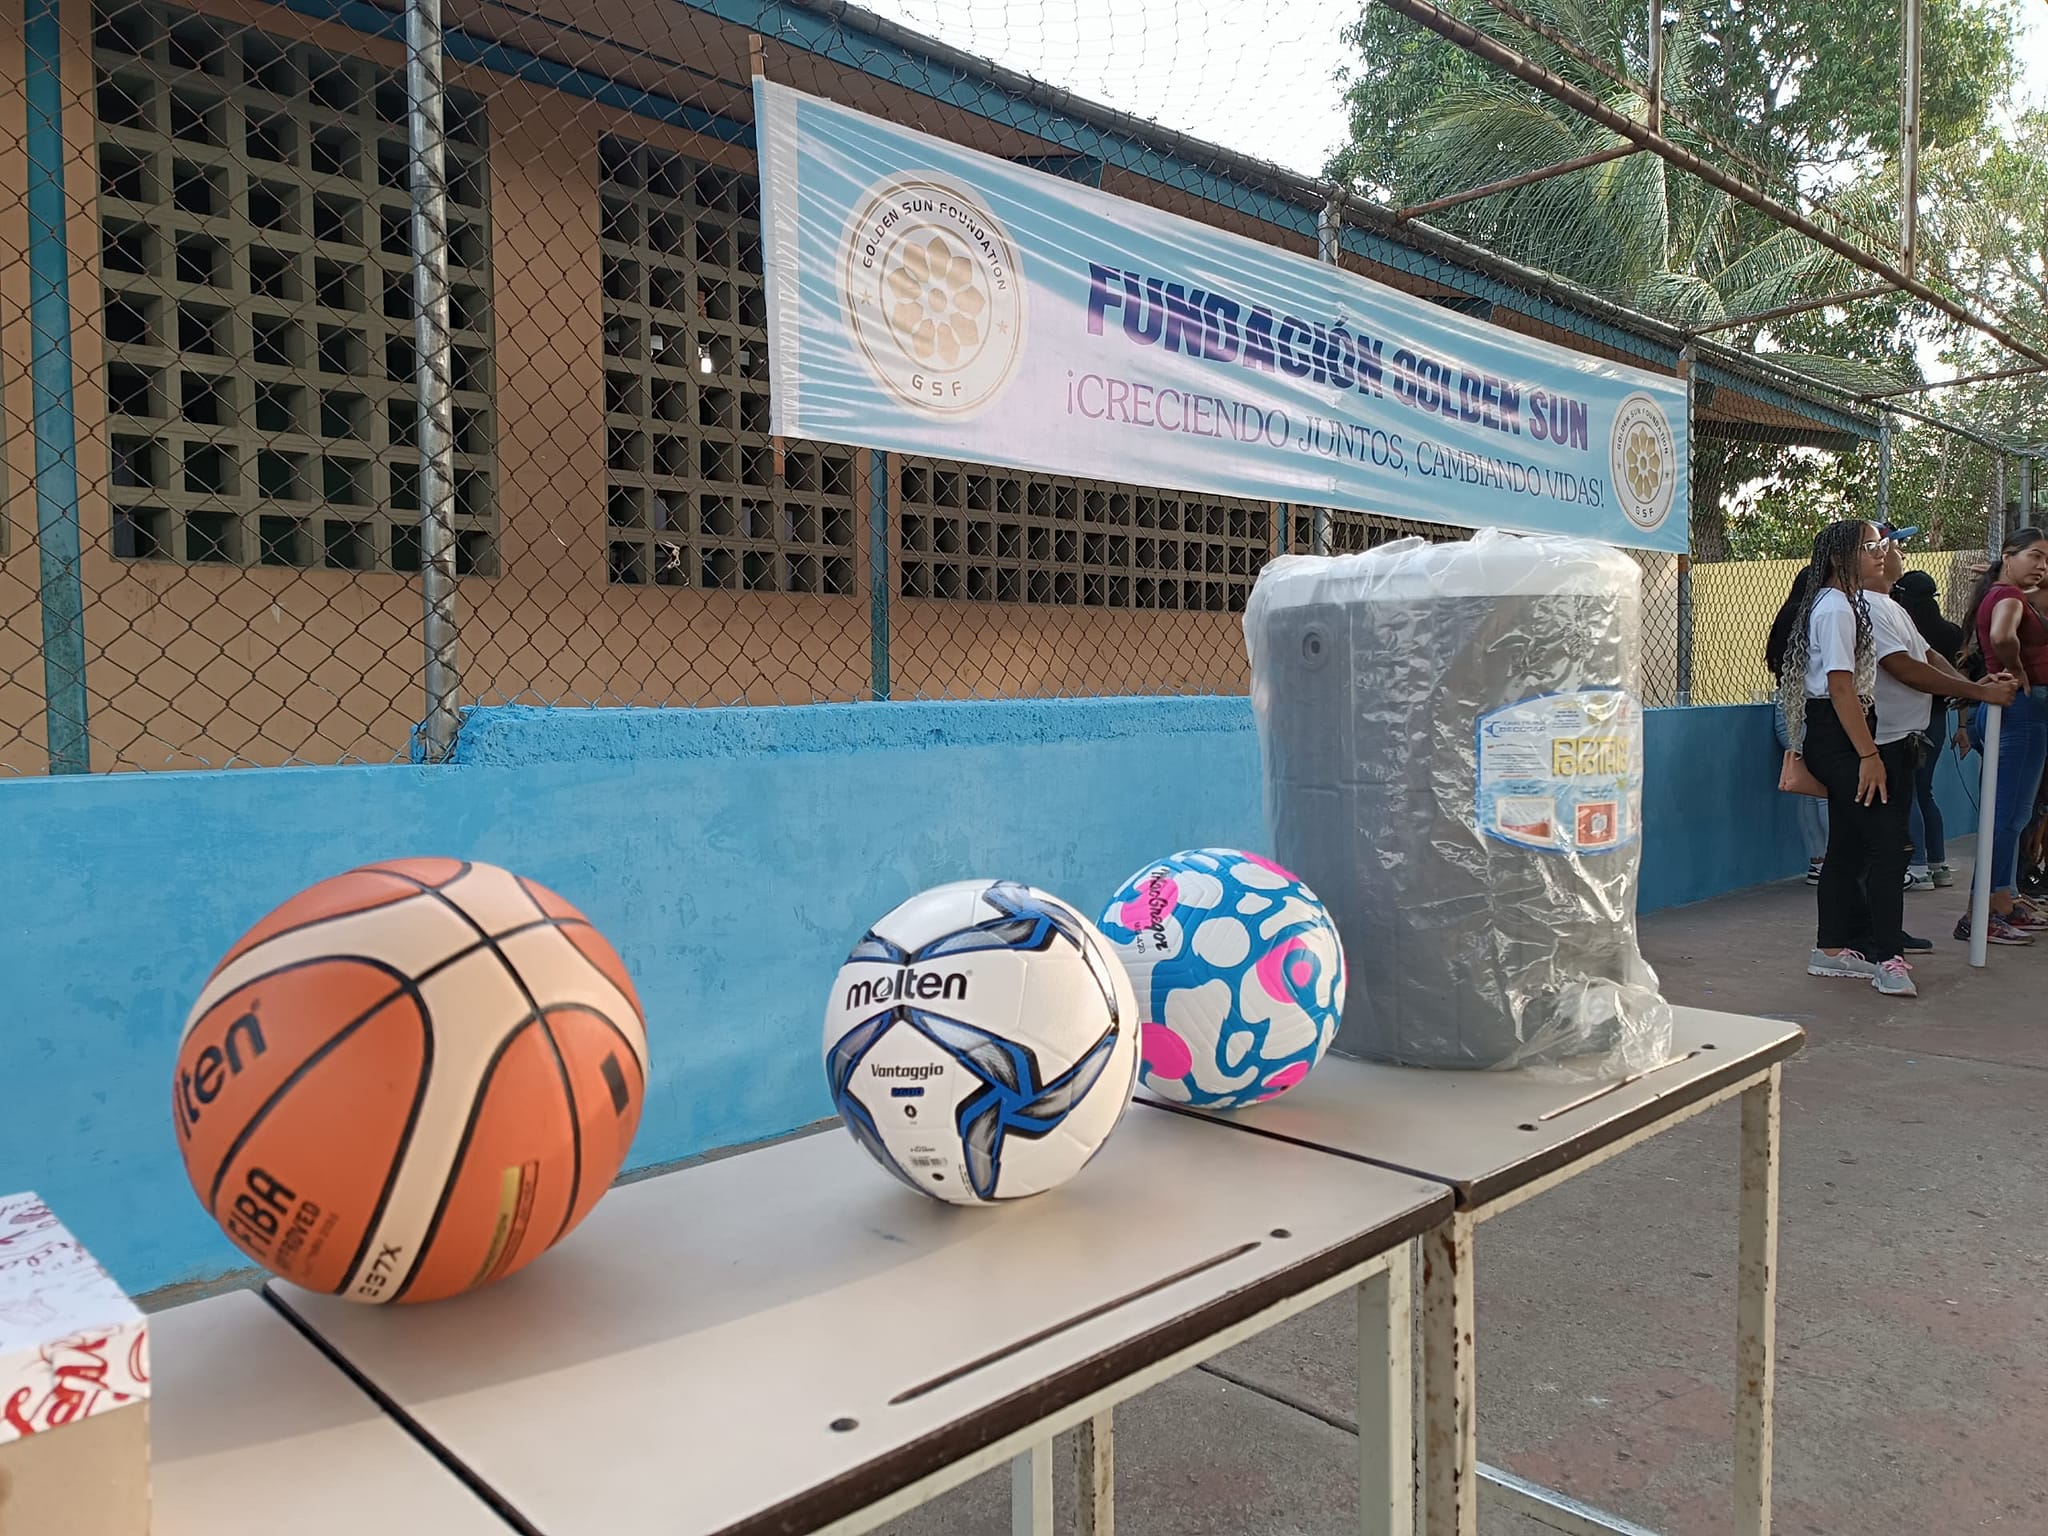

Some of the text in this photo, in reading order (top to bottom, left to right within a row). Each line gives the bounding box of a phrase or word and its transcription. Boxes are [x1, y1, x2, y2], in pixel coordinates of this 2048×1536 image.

[862, 198, 1007, 291] GOLDEN SUN FOUNDATION
[1087, 262, 1589, 451] FUNDACIÓN GOLDEN SUN
[1066, 369, 1605, 508] ¡CRECIENDO JUNTOS, CAMBIANDO VIDAS!
[846, 968, 968, 1011] molten
[871, 1063, 944, 1081] Vantaggio
[227, 1166, 297, 1257] FIBA
